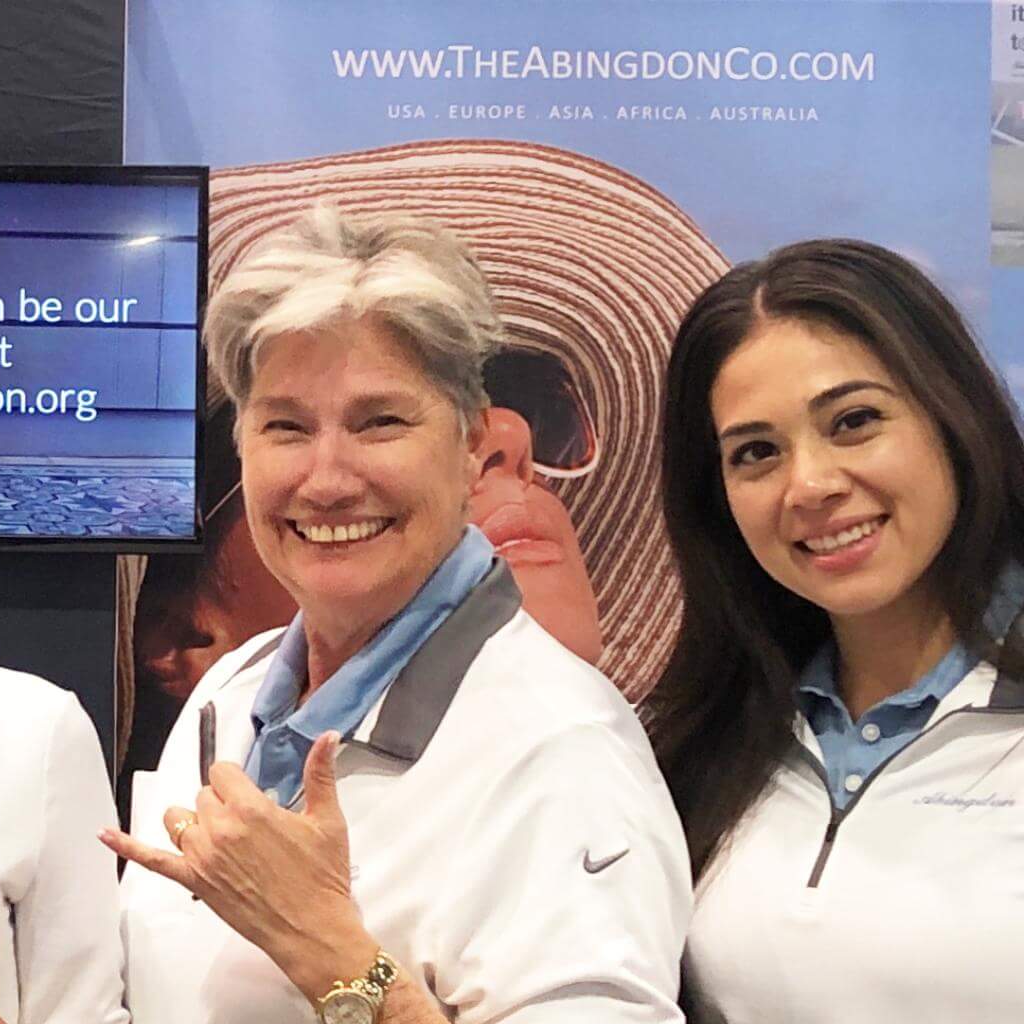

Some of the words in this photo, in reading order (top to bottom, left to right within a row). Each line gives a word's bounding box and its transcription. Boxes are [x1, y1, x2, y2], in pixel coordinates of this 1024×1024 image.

[387, 104, 426, 119] USA
[448, 104, 526, 119] EUROPE
[549, 105, 594, 120] ASIA
[616, 106, 687, 120] AFRICA
[709, 107, 819, 121] AUSTRALIA
[19, 288, 62, 322] be
[75, 297, 137, 323] our
